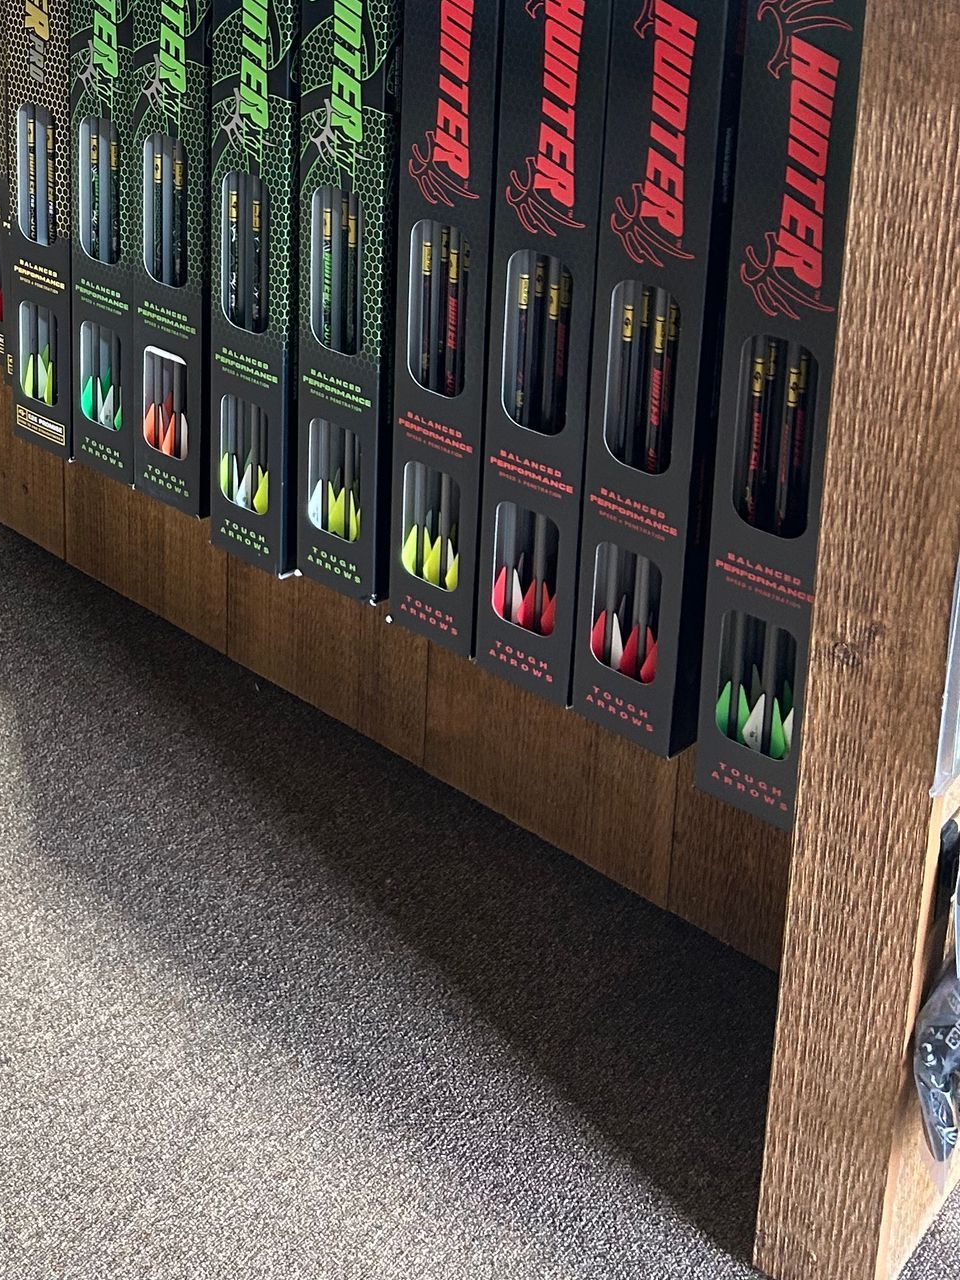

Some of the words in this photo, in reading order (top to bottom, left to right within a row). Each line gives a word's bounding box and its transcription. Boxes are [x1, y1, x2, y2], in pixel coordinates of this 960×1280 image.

[773, 34, 840, 290] HUNTER
[13, 265, 66, 290] PERFORMANCE
[19, 258, 58, 279] BALANCED
[75, 284, 130, 311] PERFORMANCE
[80, 277, 121, 299] BALANCED
[137, 306, 197, 336] PERFORMANCE
[144, 300, 188, 322] BALANCED
[214, 353, 279, 385] PERFORMANCE
[221, 346, 270, 371] BALANCED
[302, 375, 372, 409] PERFORMANCE
[310, 367, 362, 394] BALANCED
[398, 417, 474, 455] PERFORMANCE
[406, 410, 463, 439] BALANCED
[81, 444, 125, 469] ARROWS
[84, 436, 121, 459] TOUGH
[147, 463, 186, 487] TOUGH
[490, 455, 575, 495] PERFORMANCE
[499, 449, 563, 480] BALANCED
[143, 471, 190, 498] ARROWS
[589, 493, 679, 538] PERFORMANCE
[599, 486, 667, 520] BALANCED
[220, 525, 271, 556] ARROWS
[224, 518, 266, 544] TOUGH
[306, 554, 362, 585] ARROWS
[311, 546, 357, 572] TOUGH
[727, 550, 802, 587] BALANCED
[714, 558, 818, 605] PERFORMANCE
[399, 602, 459, 637] ARROWS
[405, 594, 454, 624] TOUGH
[488, 647, 554, 685] ARROWS
[494, 639, 549, 671] TOUGH
[584, 693, 655, 733] ARROWS
[591, 685, 650, 720] TOUGH
[710, 770, 789, 813] ARROWS
[718, 760, 783, 798] TOUGH
